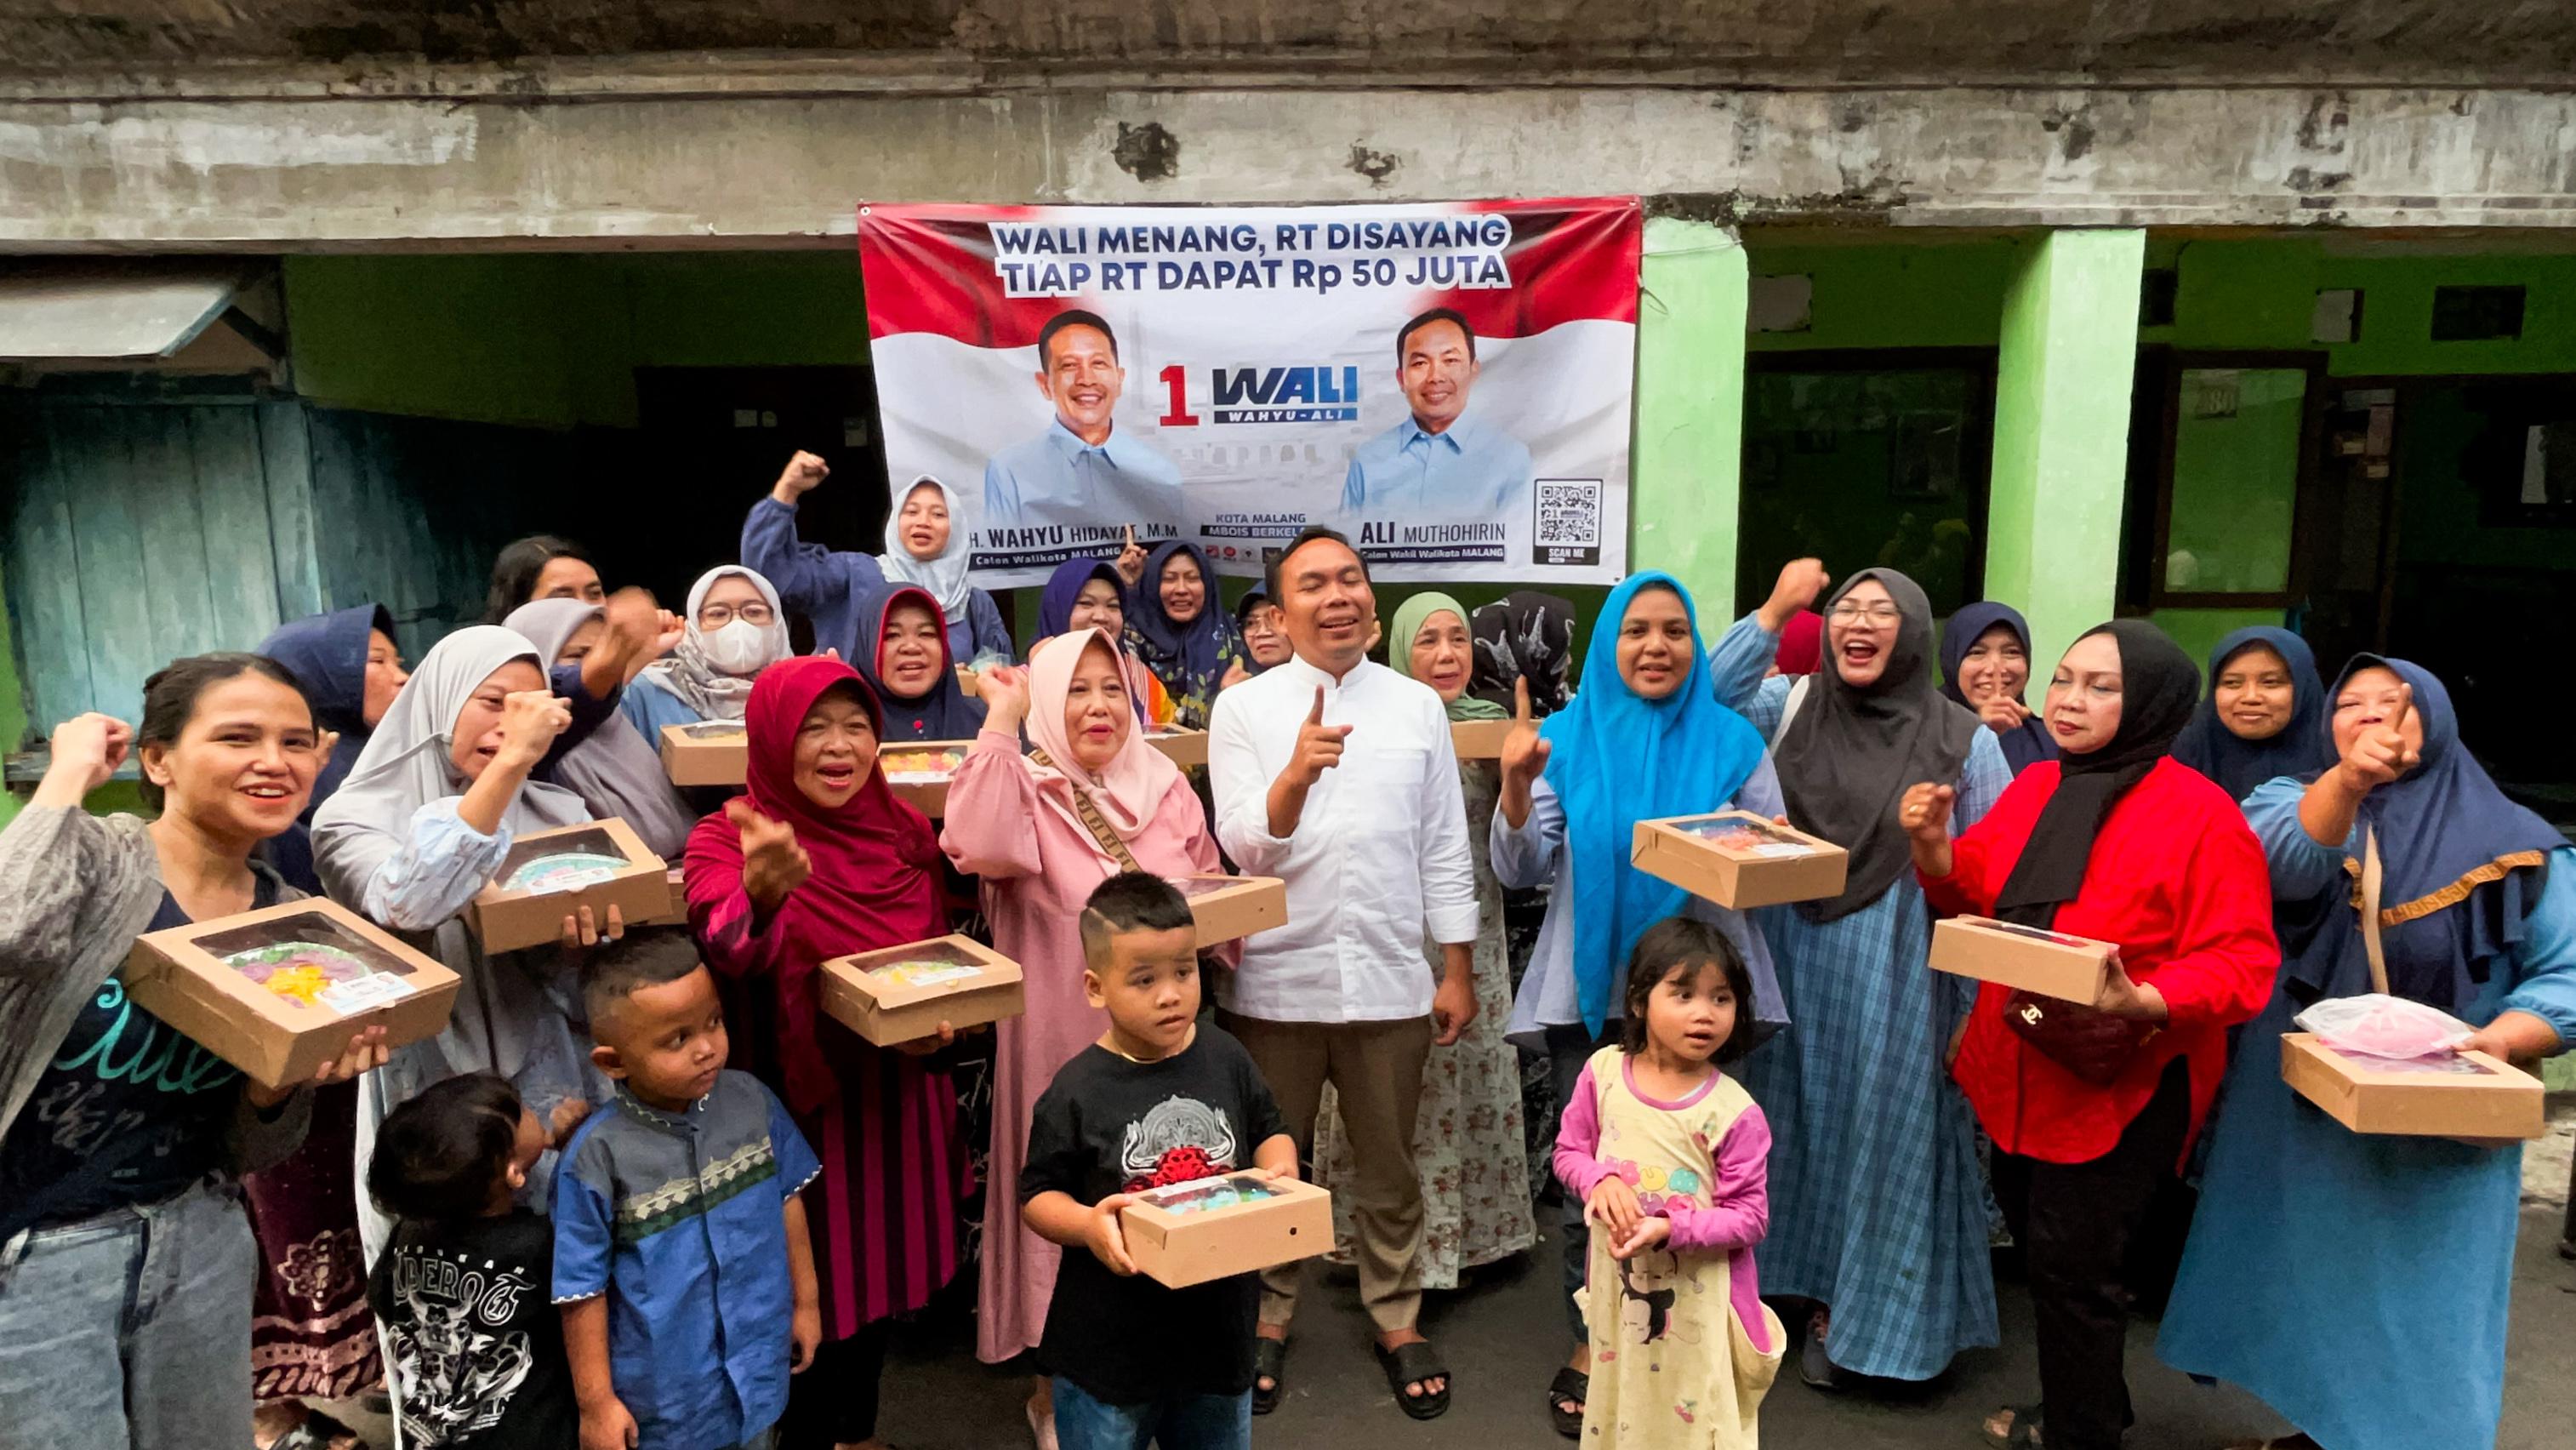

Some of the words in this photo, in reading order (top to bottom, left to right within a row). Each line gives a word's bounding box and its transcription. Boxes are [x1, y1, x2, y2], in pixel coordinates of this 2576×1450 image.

[996, 226, 1086, 254] WALI
[1098, 224, 1266, 256] MENANG,
[1277, 225, 1318, 252] RT
[1328, 220, 1506, 250] DISAYANG
[1001, 262, 1091, 292] TIAP
[1102, 261, 1147, 290] RT
[1158, 260, 1278, 290] DAPAT
[1293, 260, 1342, 294] Rp
[1353, 259, 1396, 287] 50
[1405, 256, 1505, 286] JUTA
[1160, 365, 1199, 425] 1
[1212, 366, 1358, 405] WALI
[1216, 514, 1248, 523] KOTA
[1252, 513, 1306, 523] MALANG
[988, 525, 1063, 548] WAHYU
[1209, 526, 1249, 536] MBOIS
[1360, 522, 1395, 544] ALI
[1404, 523, 1505, 543] MUTHOHIRIN
[976, 556, 1009, 565] Calon
[1012, 553, 1067, 563] Walikota
[1071, 546, 1120, 558] MALANG
[1462, 548, 1503, 557] MALANG
[1548, 548, 1571, 557] SCAN
[1573, 548, 1585, 557] ME
